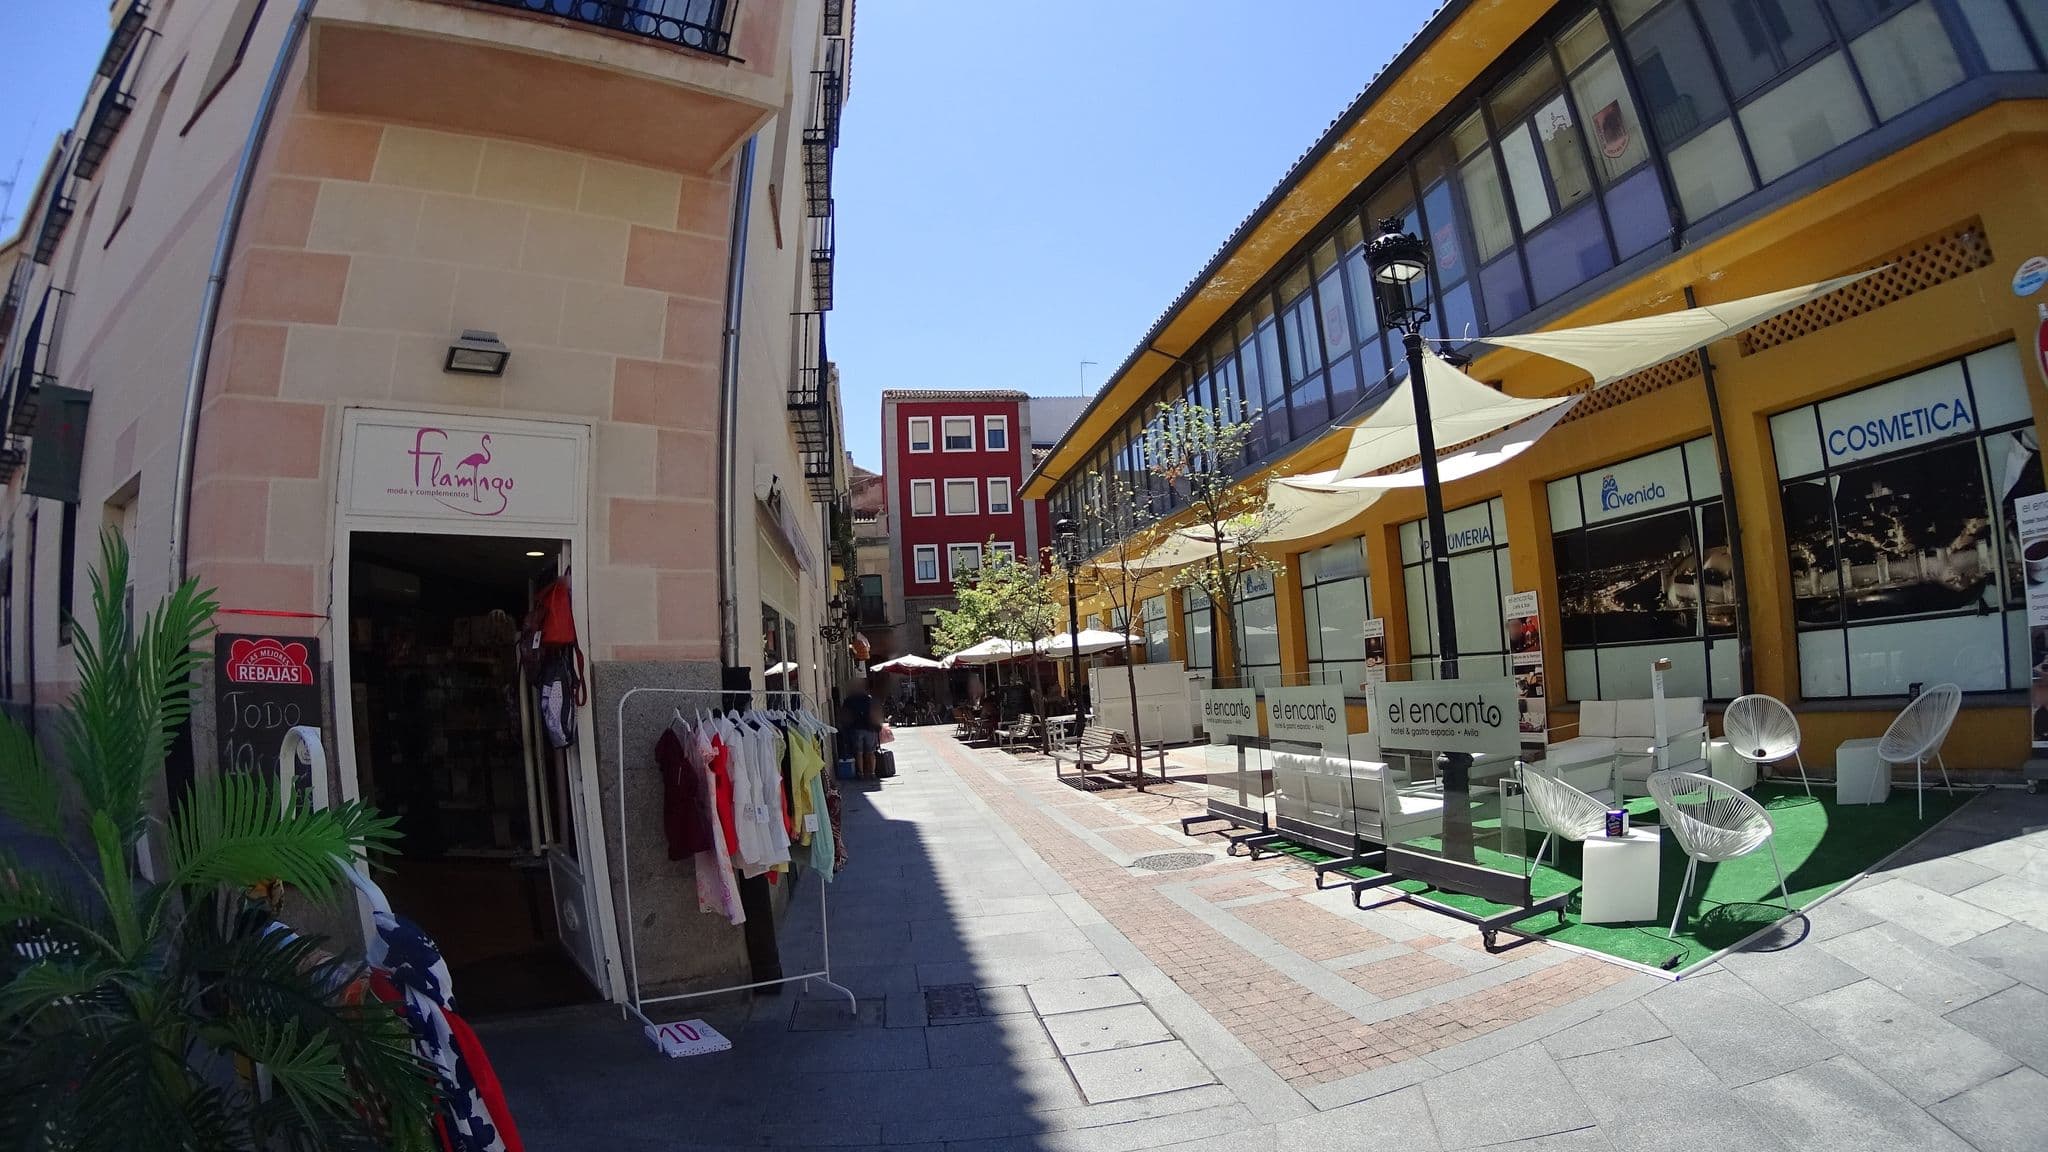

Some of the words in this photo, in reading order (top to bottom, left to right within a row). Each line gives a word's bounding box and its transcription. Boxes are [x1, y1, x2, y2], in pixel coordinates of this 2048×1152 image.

[1829, 398, 1972, 456] COSMETICA
[387, 487, 407, 495] moda
[416, 488, 470, 498] complementos
[1423, 526, 1491, 555] PUMERIA
[247, 653, 259, 665] LAS
[260, 649, 290, 666] MEJORES
[239, 665, 299, 682] REBAJAS
[1205, 698, 1213, 716] el
[1214, 698, 1251, 719] encanto
[1272, 698, 1282, 720] el
[1284, 698, 1337, 724] encanto
[1388, 696, 1404, 723] el
[1409, 694, 1501, 728] encanto
[1390, 727, 1404, 735] hotel
[1411, 728, 1429, 737] gastro
[1430, 728, 1455, 737] espacio
